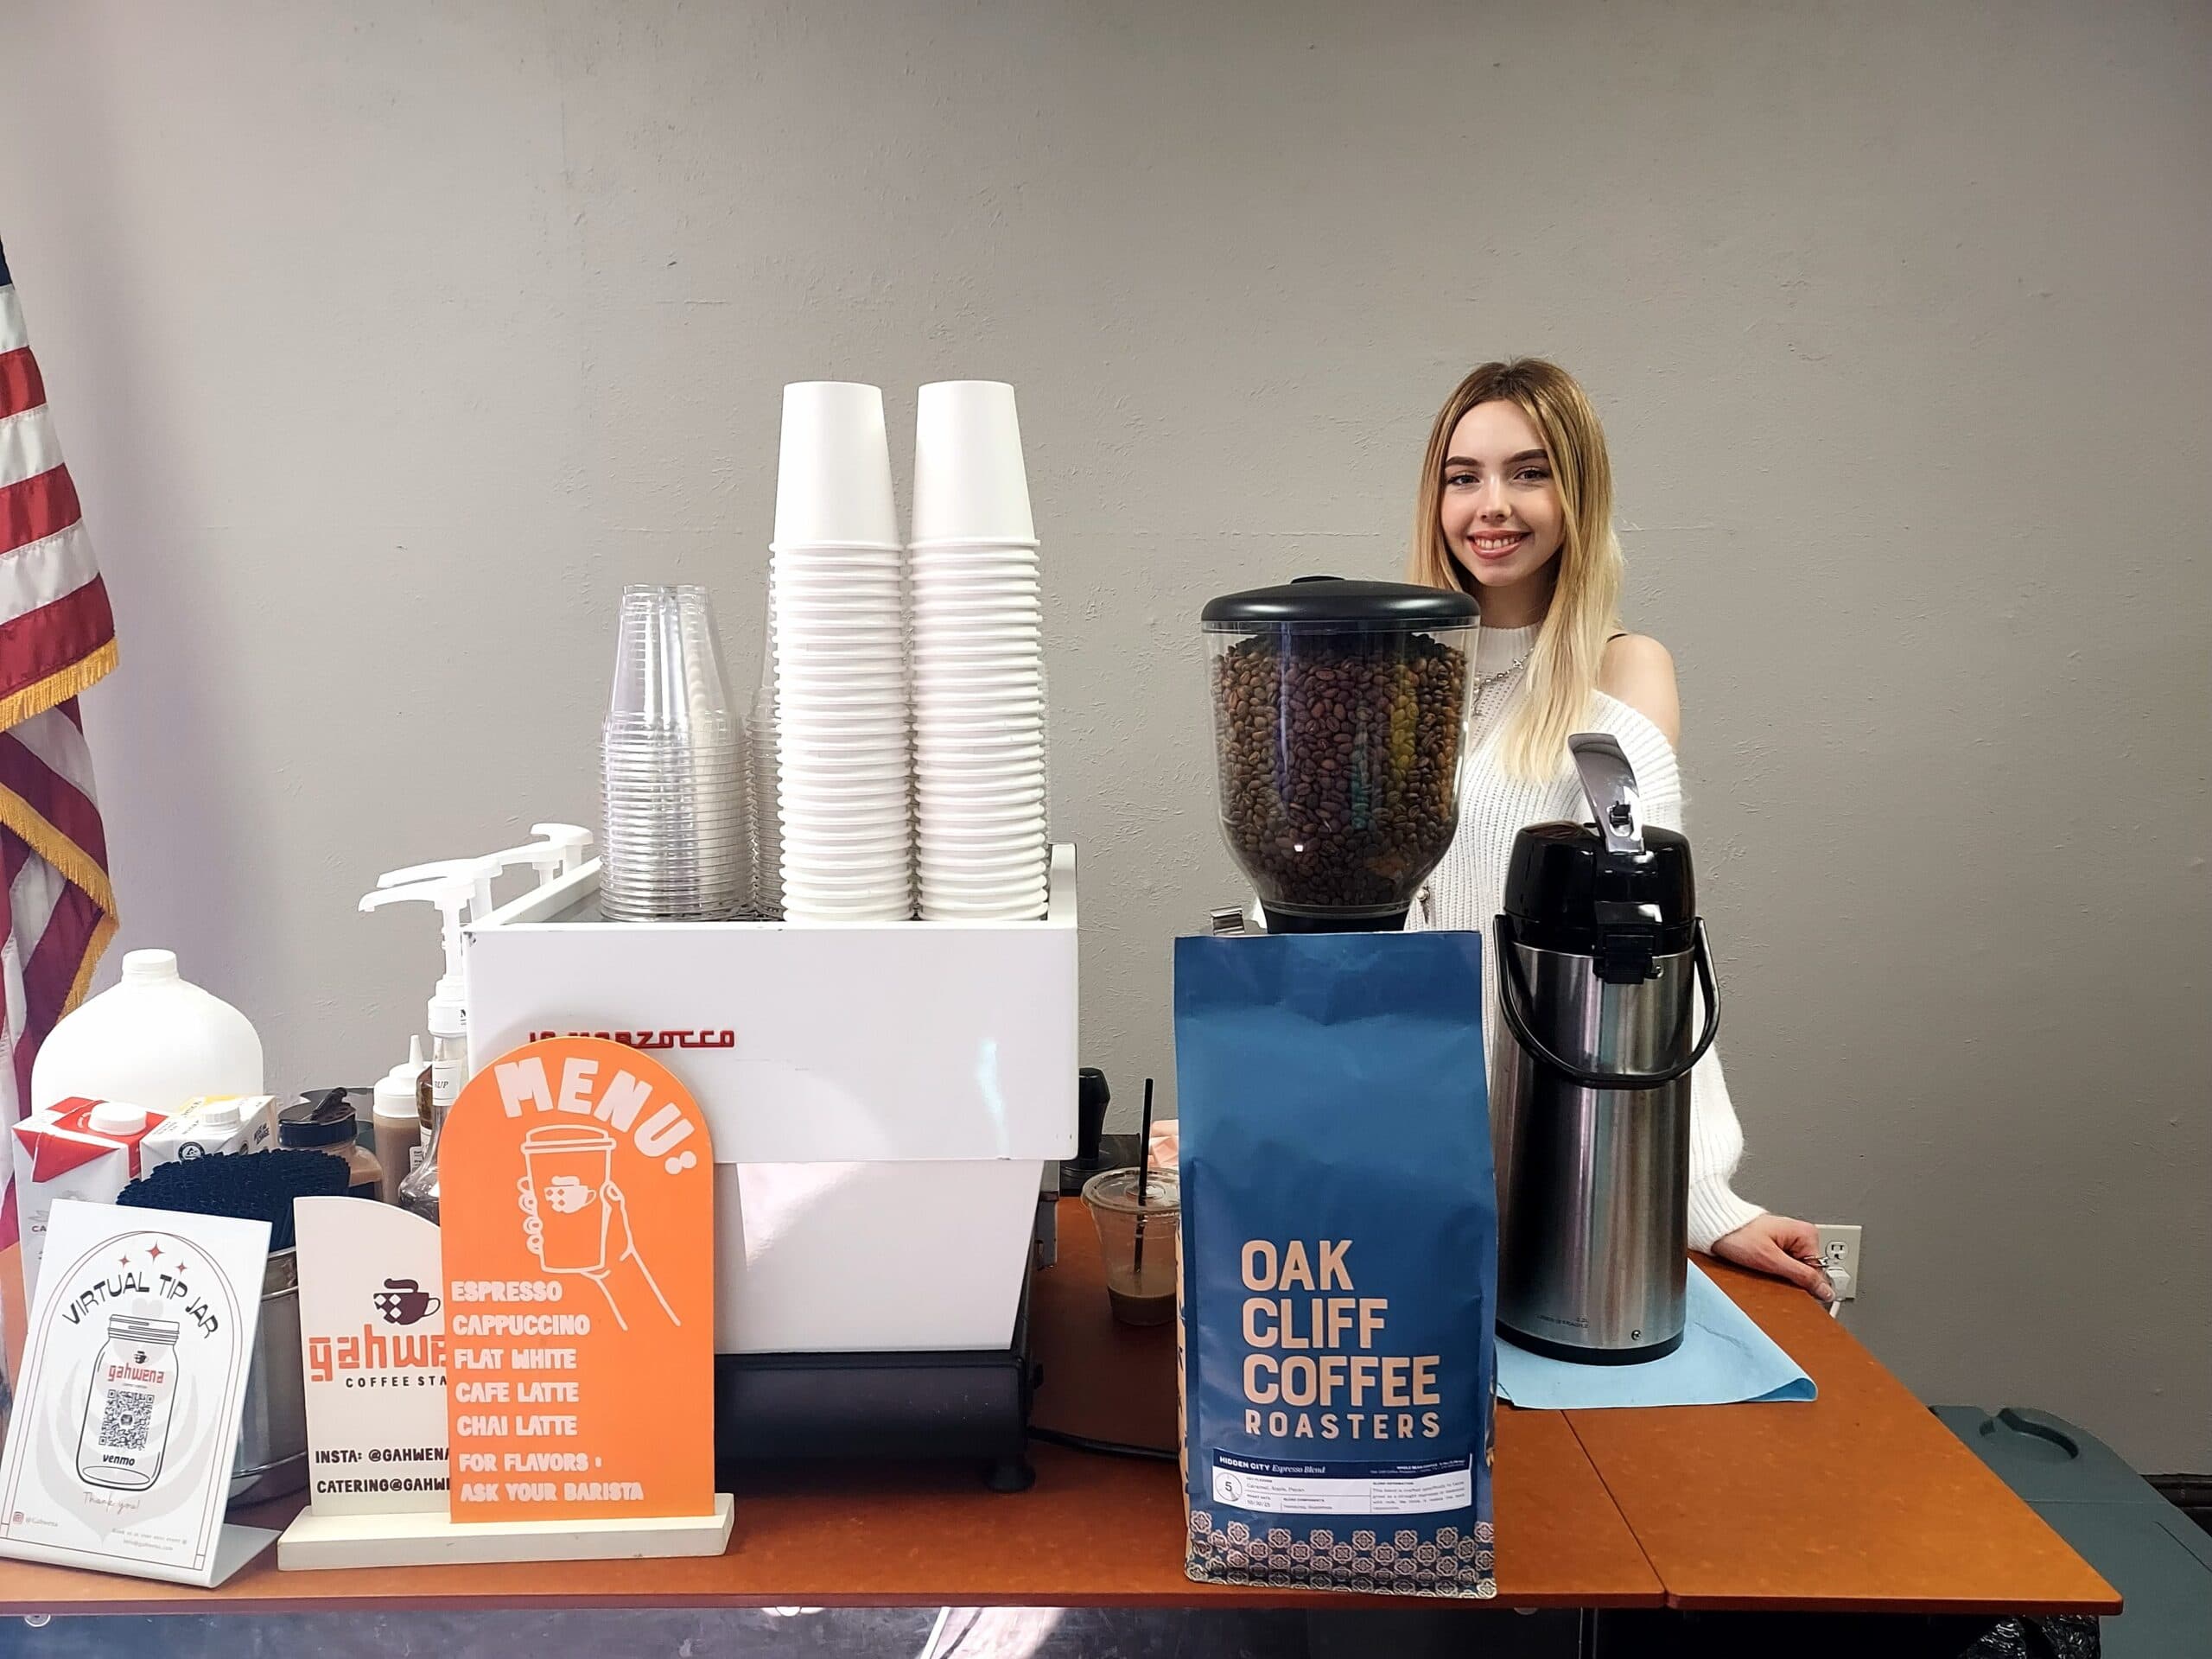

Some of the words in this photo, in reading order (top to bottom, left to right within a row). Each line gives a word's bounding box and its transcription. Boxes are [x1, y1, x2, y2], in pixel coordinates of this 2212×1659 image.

[1241, 1239, 1355, 1292] OAK
[451, 1281, 563, 1302] ESPRESSO
[62, 1271, 150, 1325] VIRTUAL
[159, 1274, 188, 1300] TIP
[185, 1296, 219, 1338] JAR
[453, 1314, 591, 1336] CAPPUCCINO
[1242, 1297, 1389, 1350] CLIFF
[454, 1348, 504, 1370] FLAT
[511, 1348, 577, 1370] WHITE
[107, 1363, 165, 1383] gahwena
[346, 1376, 410, 1388] COFFEE
[417, 1376, 447, 1386] STA
[1243, 1354, 1440, 1408] COFFEE
[455, 1382, 511, 1403] CAFE
[517, 1382, 580, 1402] LATTE
[456, 1415, 508, 1436] CHAI
[516, 1415, 578, 1436] LATTE
[1244, 1409, 1440, 1440] ROASTERS
[102, 1454, 136, 1466] venmo
[315, 1450, 362, 1464] INSTA:
[459, 1453, 498, 1472] FOR
[504, 1452, 589, 1472] FLAVORS
[1219, 1456, 1249, 1469] HIDDEN
[1249, 1463, 1270, 1471] CITY
[1272, 1464, 1303, 1474] Espresso
[1304, 1465, 1325, 1474] Blend
[461, 1483, 499, 1502] ASK
[505, 1483, 557, 1502] YOUR
[564, 1482, 645, 1501] BARISTA
[1224, 1481, 1232, 1492] 5
[83, 1491, 115, 1513] Thank
